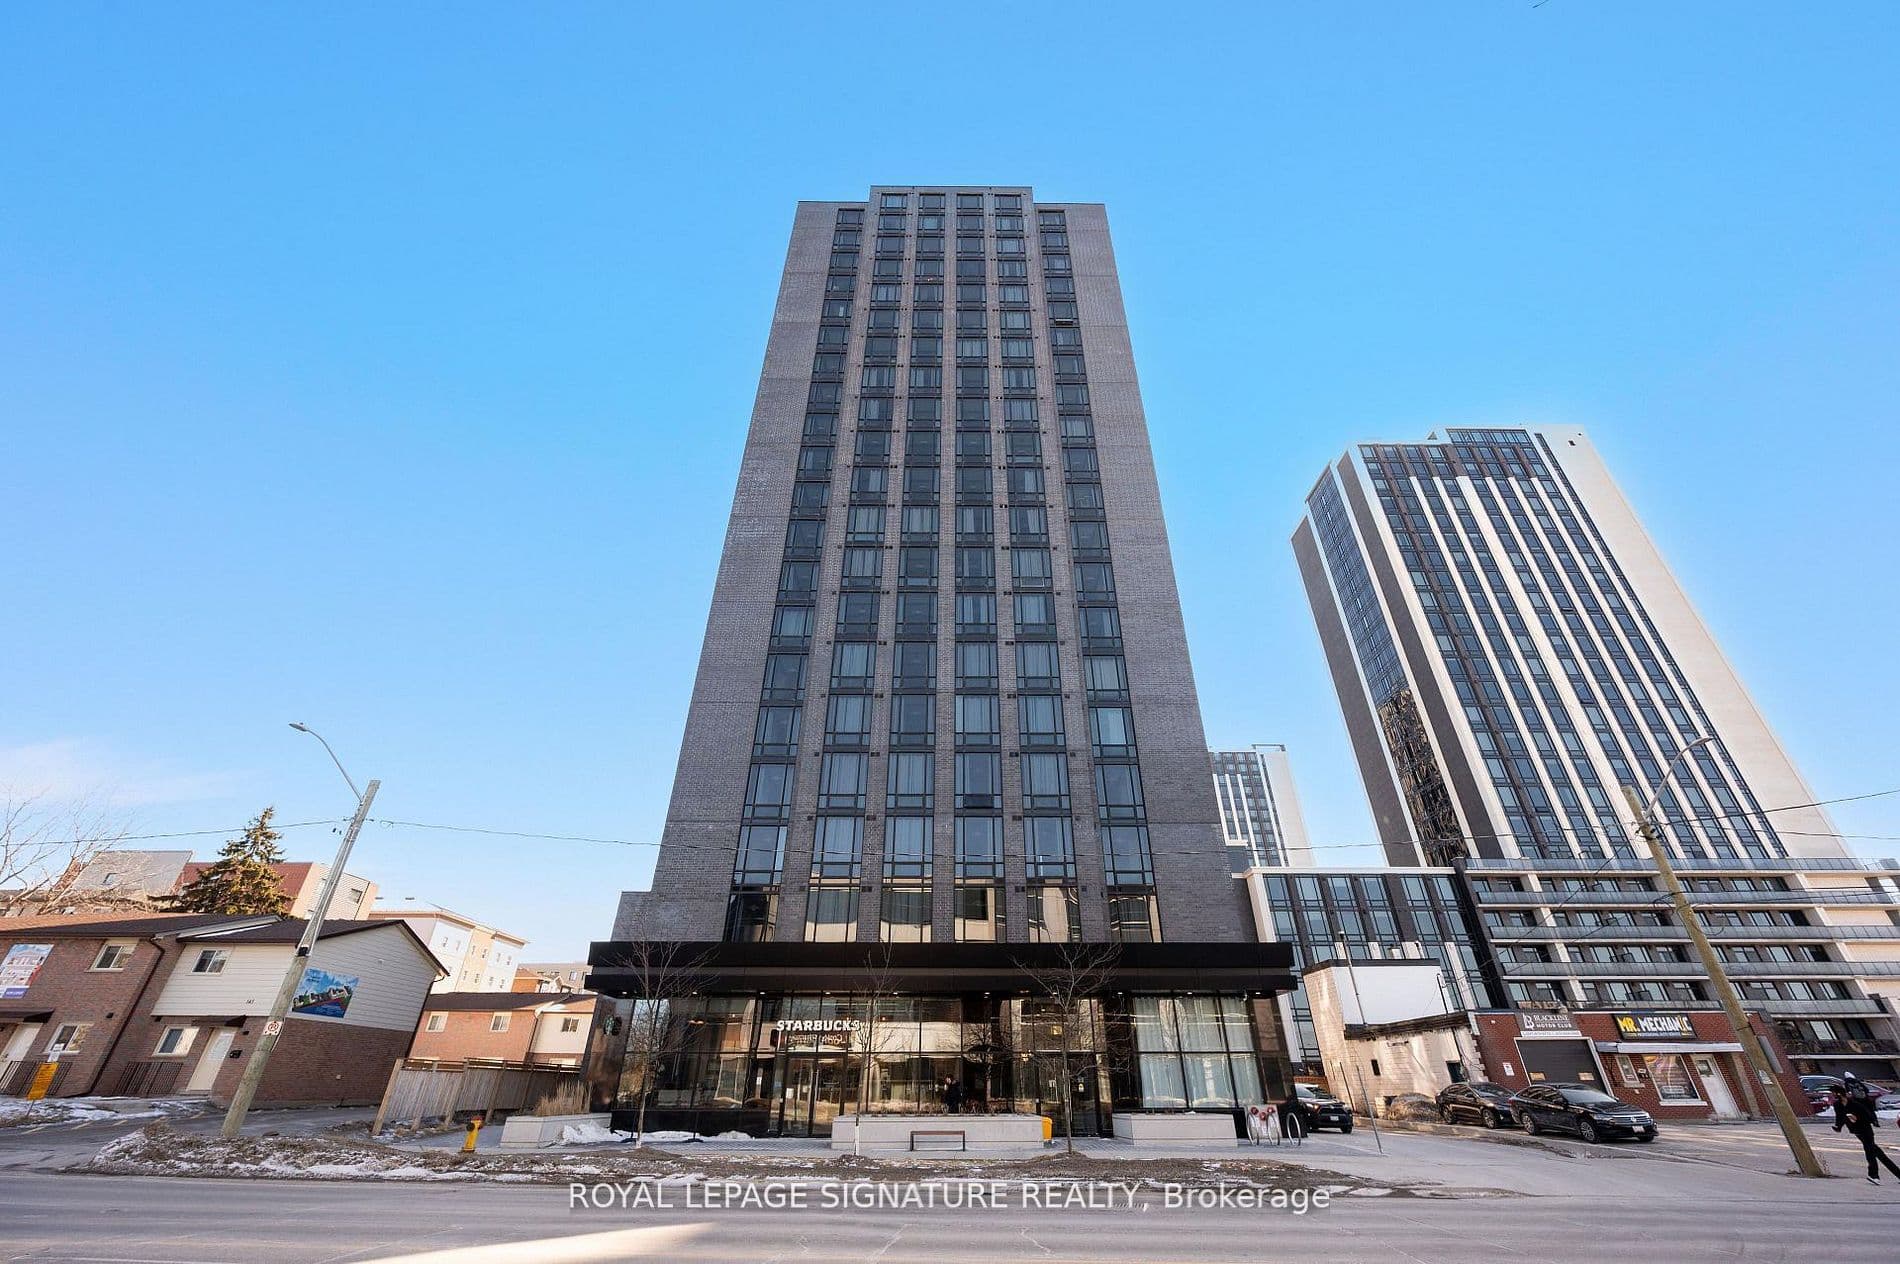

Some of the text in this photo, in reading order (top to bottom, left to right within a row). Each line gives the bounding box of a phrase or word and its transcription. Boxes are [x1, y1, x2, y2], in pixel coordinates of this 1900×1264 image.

[776, 1019, 861, 1032] STARBUCKS
[1616, 1015, 1693, 1032] MR. MECHANIC
